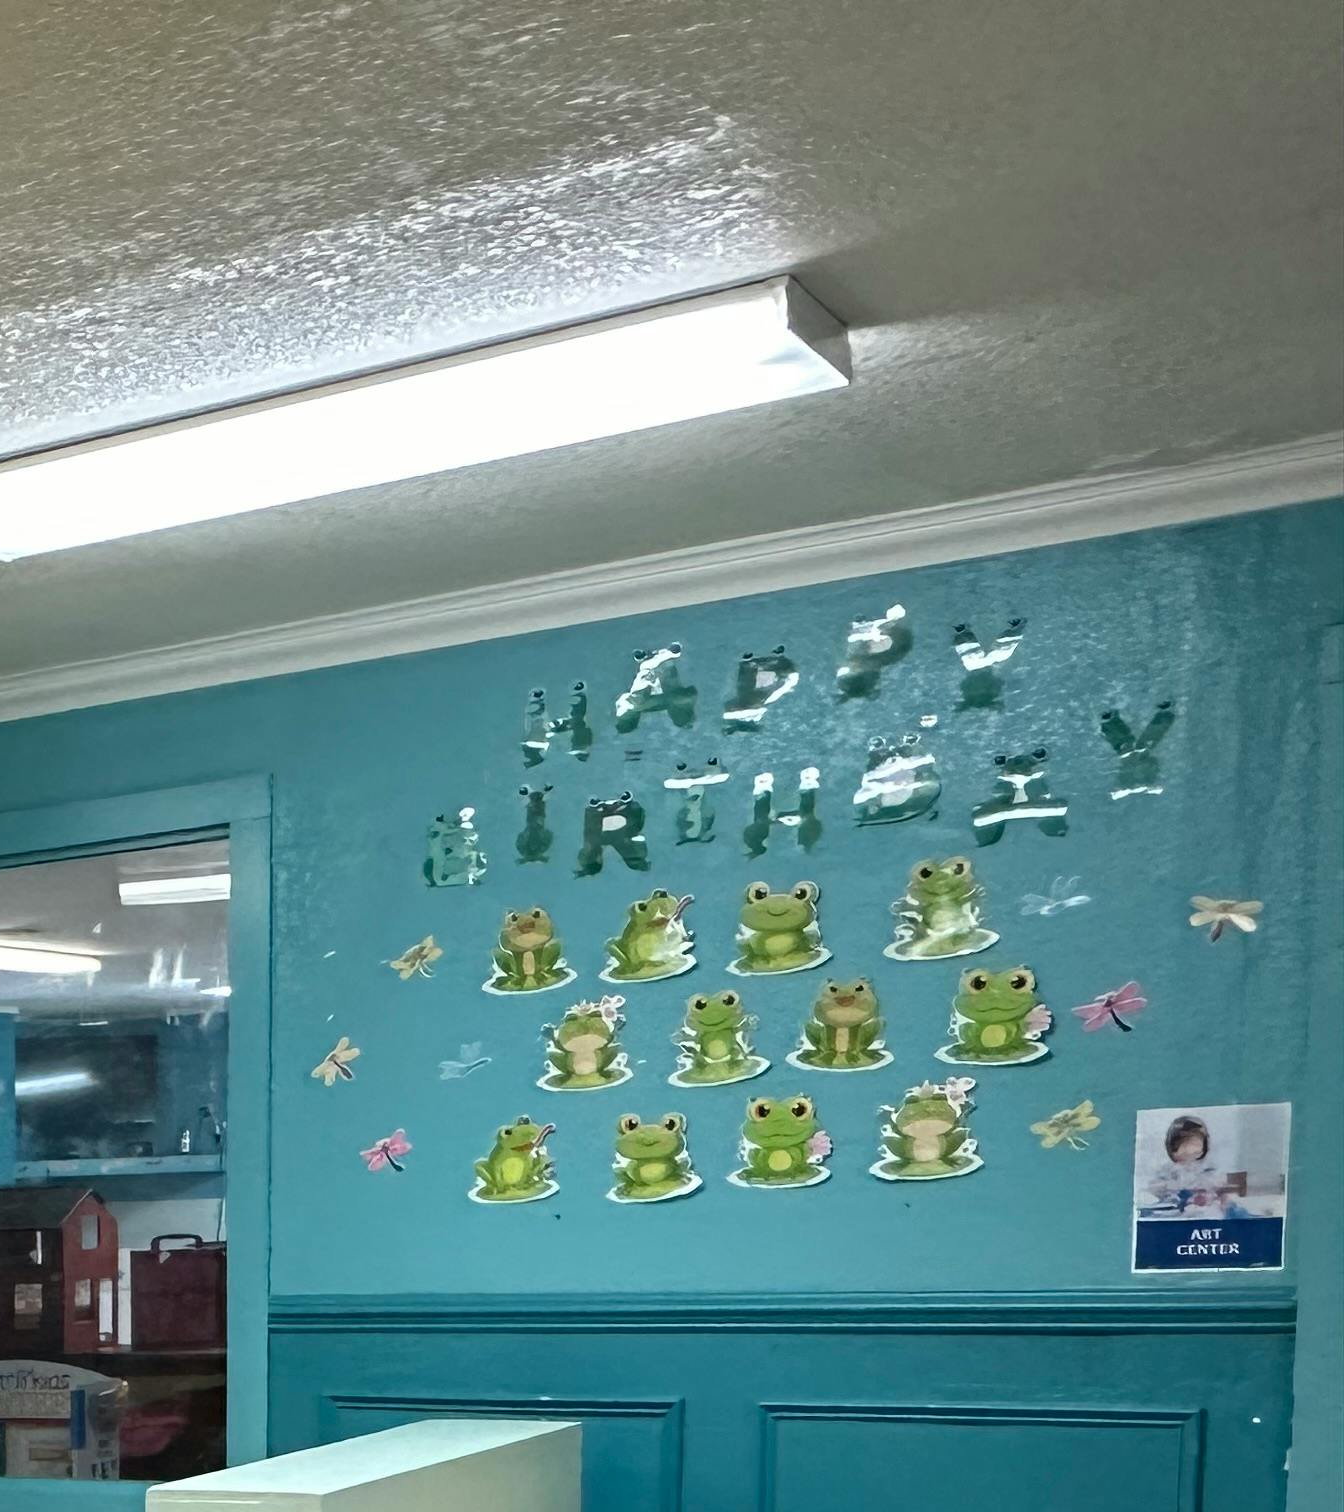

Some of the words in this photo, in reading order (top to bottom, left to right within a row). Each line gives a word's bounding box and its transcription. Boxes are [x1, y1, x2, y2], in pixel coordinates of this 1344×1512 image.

[520, 604, 1028, 768] HAPPY
[423, 700, 1177, 889] BIRTHDAY
[1176, 1243, 1240, 1256] CENTER
[1190, 1228, 1223, 1241] ART
